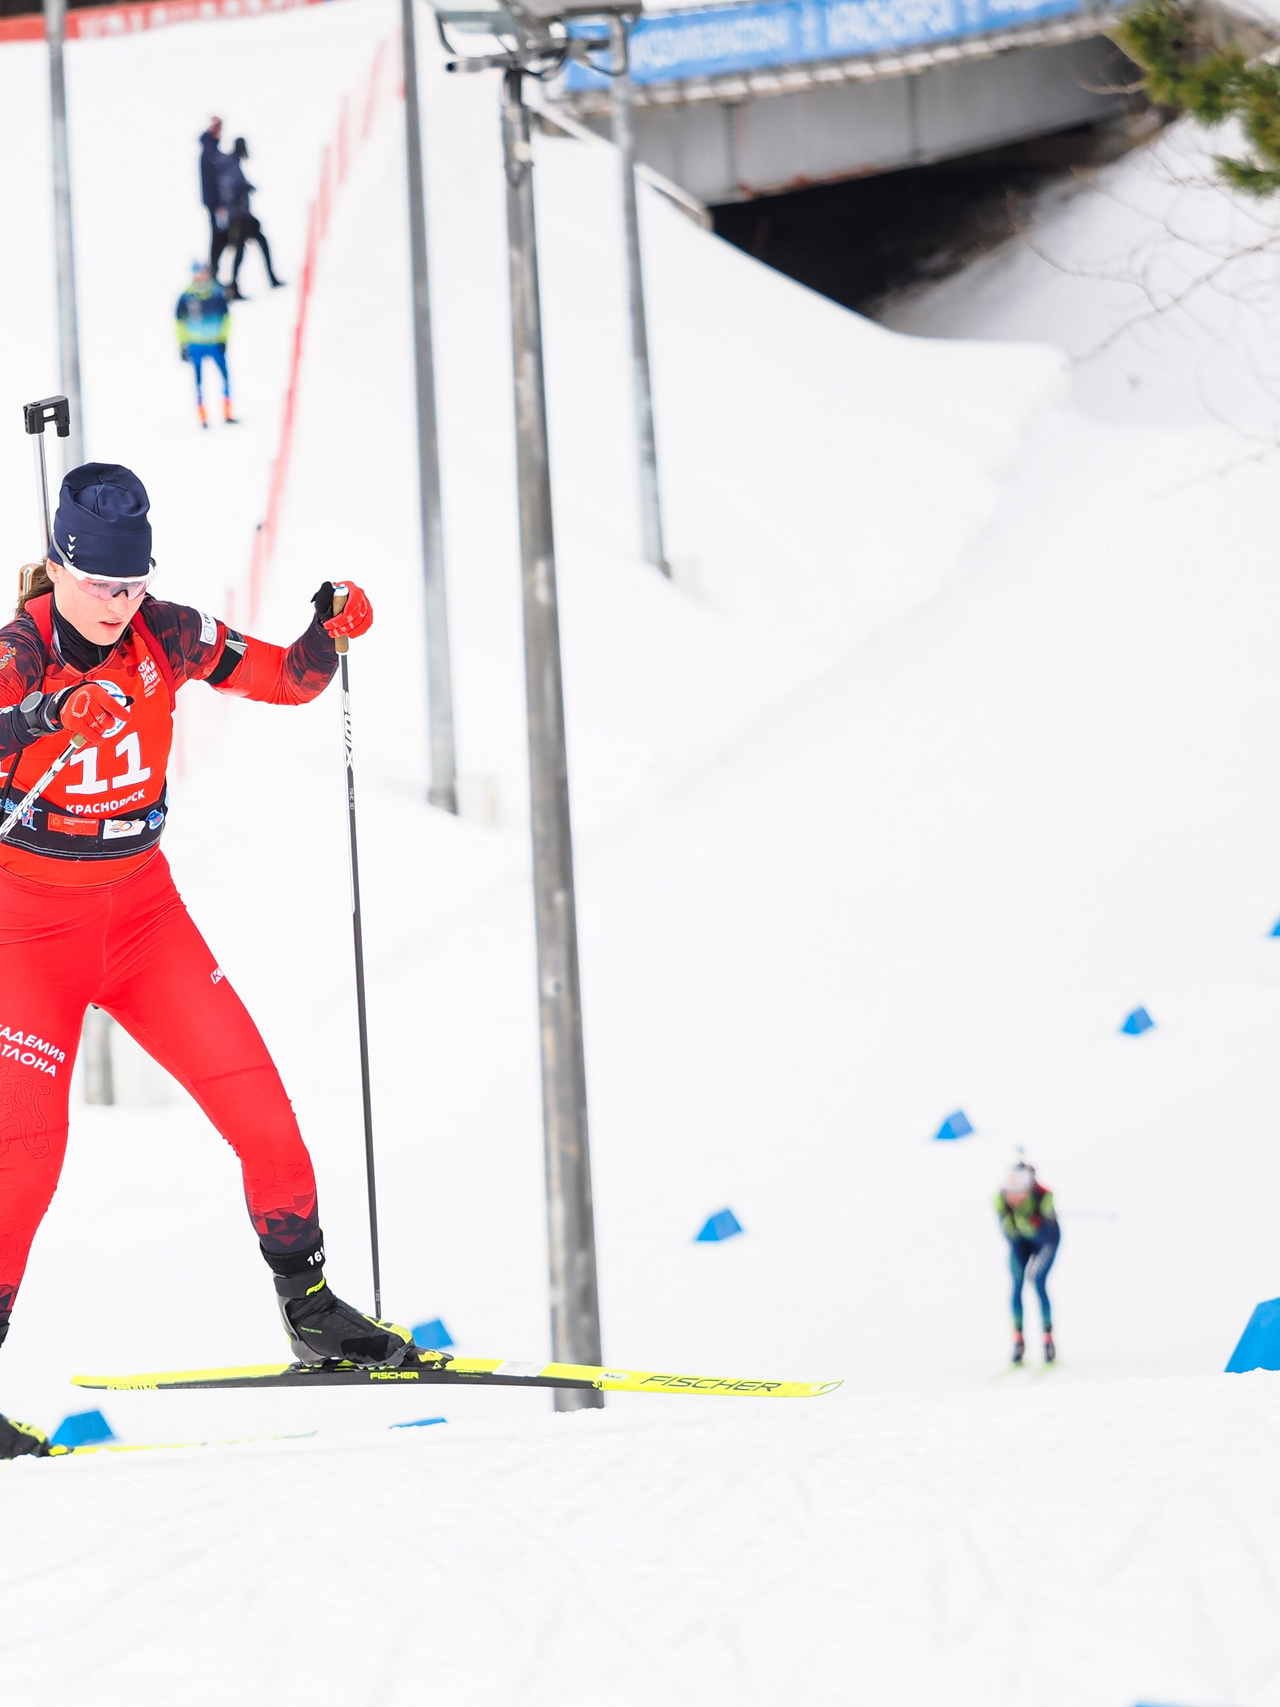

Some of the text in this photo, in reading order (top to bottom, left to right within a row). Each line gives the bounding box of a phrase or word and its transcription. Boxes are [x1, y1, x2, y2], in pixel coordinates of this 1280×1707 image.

[65, 731, 151, 795] 11
[66, 789, 145, 814] КРАСНОЯРСК
[370, 1370, 419, 1380] FISCHER
[640, 1375, 782, 1392] FISCHER
